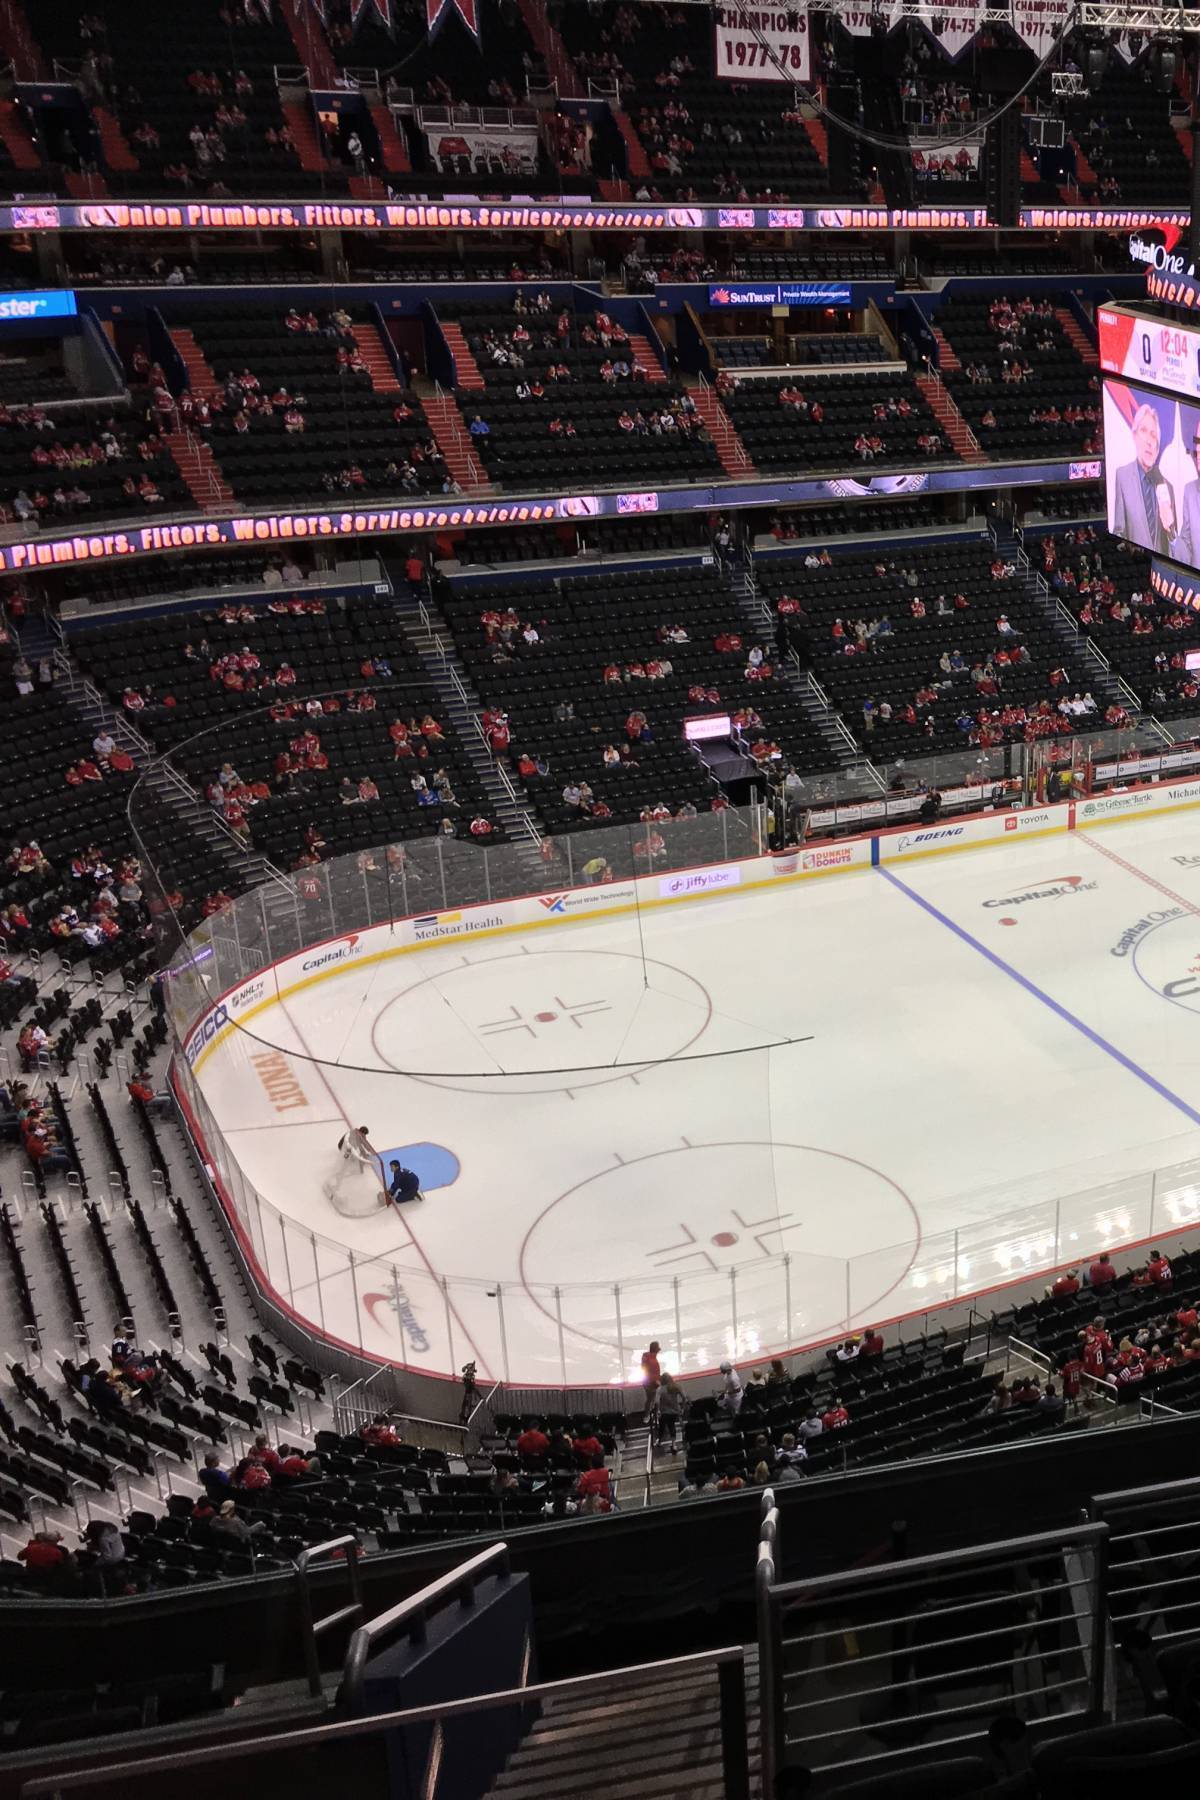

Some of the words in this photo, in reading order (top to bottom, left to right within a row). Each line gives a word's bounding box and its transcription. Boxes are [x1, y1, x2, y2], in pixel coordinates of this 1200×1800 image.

[1020, 21, 1062, 38] 1977-7
[725, 41, 801, 69] 197778
[116, 205, 182, 227] Union
[187, 205, 300, 227] Plumbers,
[305, 206, 382, 227] Fitters,
[843, 209, 887, 228] Union
[892, 209, 970, 228] Plumbers,
[1154, 245, 1184, 274] One
[1142, 333, 1152, 365] 0
[1160, 329, 1188, 358] 12:04
[11, 533, 135, 568] Plumbers,
[140, 521, 227, 549] Fitters,
[1020, 814, 1049, 825] TOYOTA
[913, 827, 964, 843] BOEING
[816, 856, 851, 867] DONUTS
[686, 876, 707, 889] jiffy
[708, 873, 729, 884] lube
[981, 884, 1060, 909] Capital
[1059, 879, 1098, 899] One
[415, 925, 461, 941] MedStar
[465, 917, 503, 931] Health
[1111, 918, 1149, 958] Capital
[1148, 906, 1184, 924] One
[302, 949, 343, 971] Capital
[185, 1004, 228, 1066] GEICO
